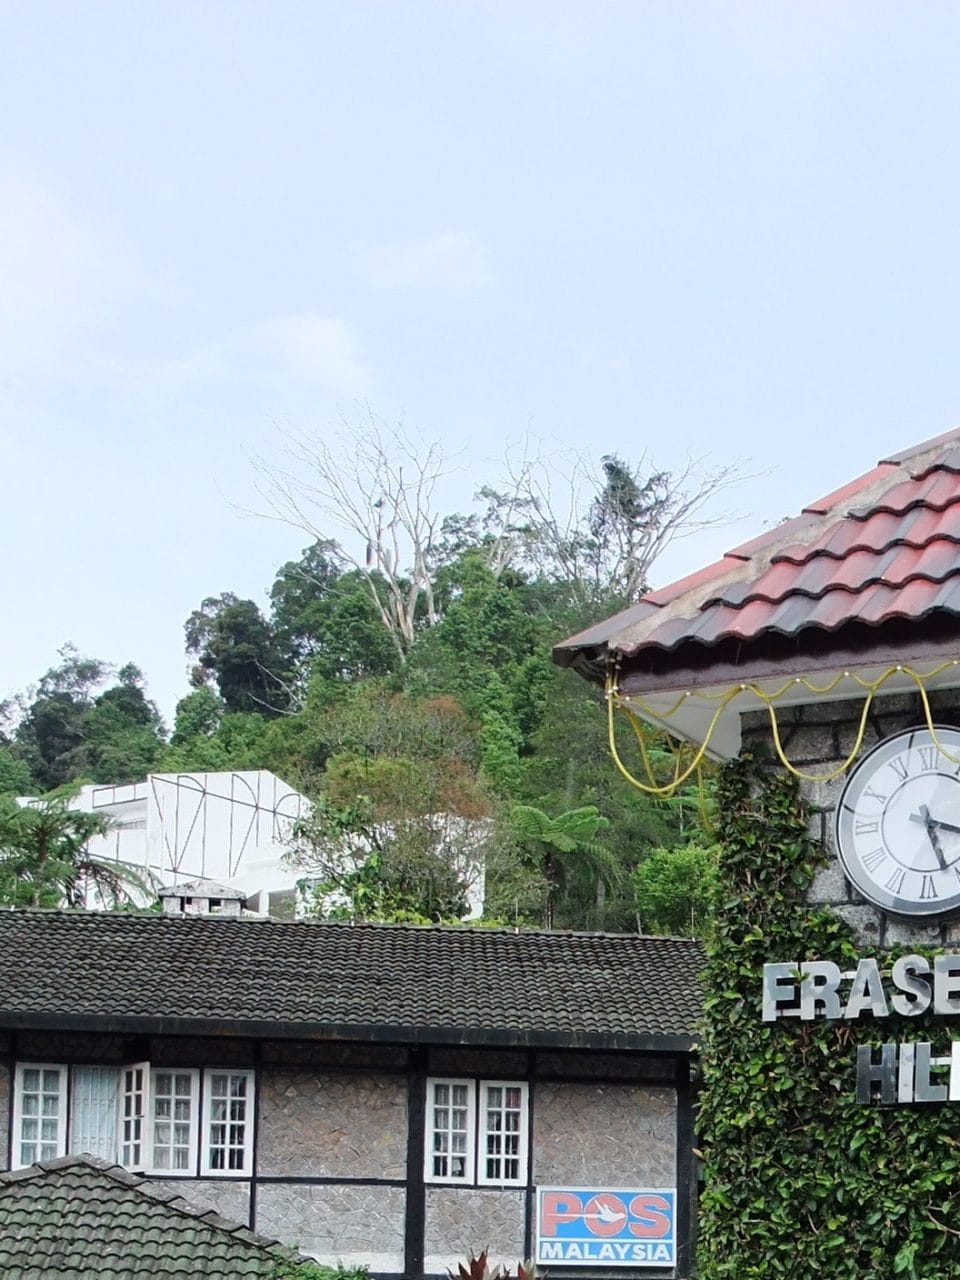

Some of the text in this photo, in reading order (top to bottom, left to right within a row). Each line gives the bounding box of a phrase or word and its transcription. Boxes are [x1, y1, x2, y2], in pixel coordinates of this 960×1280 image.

[863, 785, 887, 804] X
[919, 875, 939, 899] VI
[542, 1192, 671, 1238] POS
[541, 1242, 671, 1261] MALAYSIA
